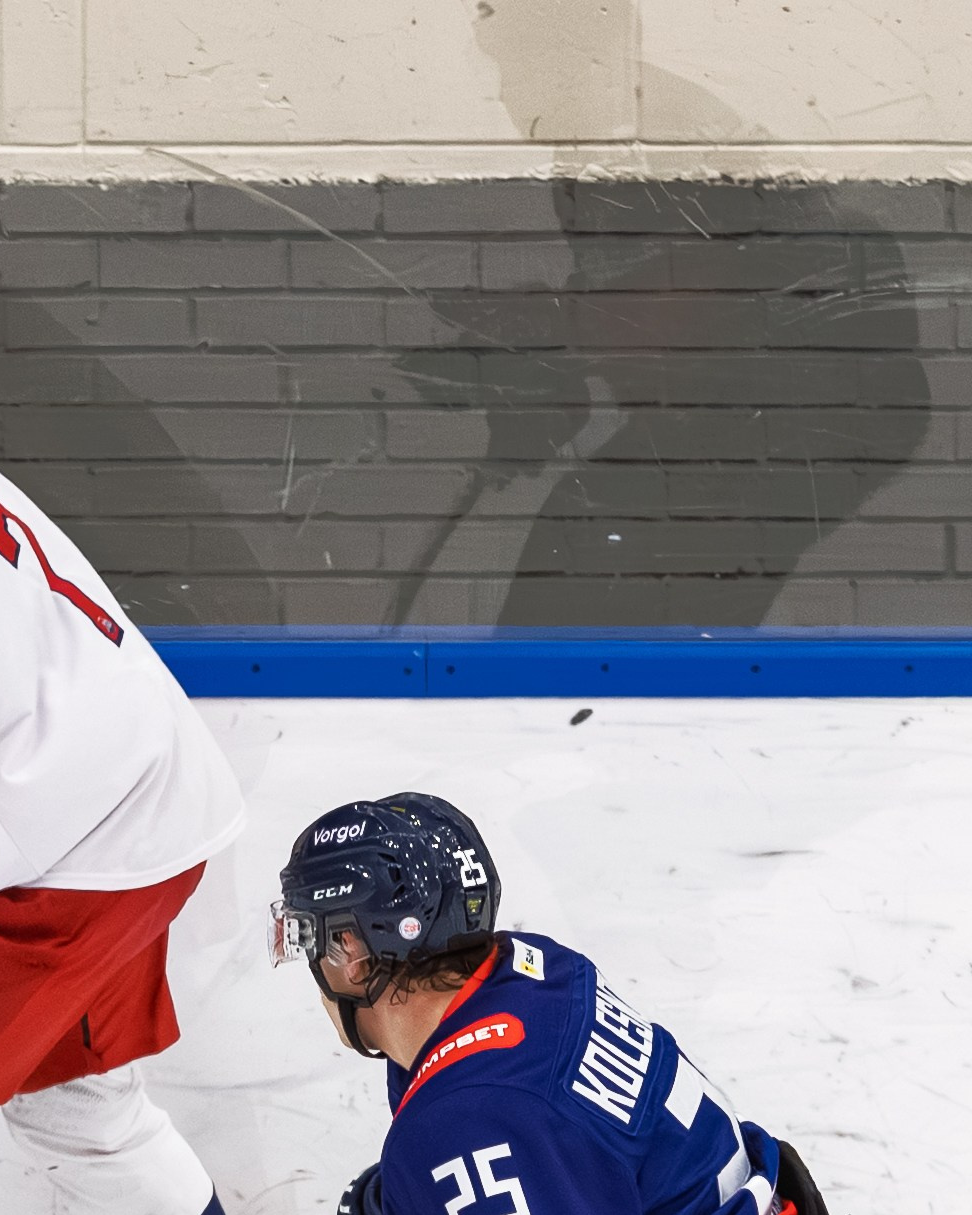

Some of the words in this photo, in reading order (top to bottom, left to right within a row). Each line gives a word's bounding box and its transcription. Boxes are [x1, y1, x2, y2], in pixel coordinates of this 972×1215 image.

[314, 820, 367, 846] Vorgol
[452, 848, 488, 888] 25
[313, 883, 353, 901] CCM
[407, 1022, 509, 1092] IMPBET
